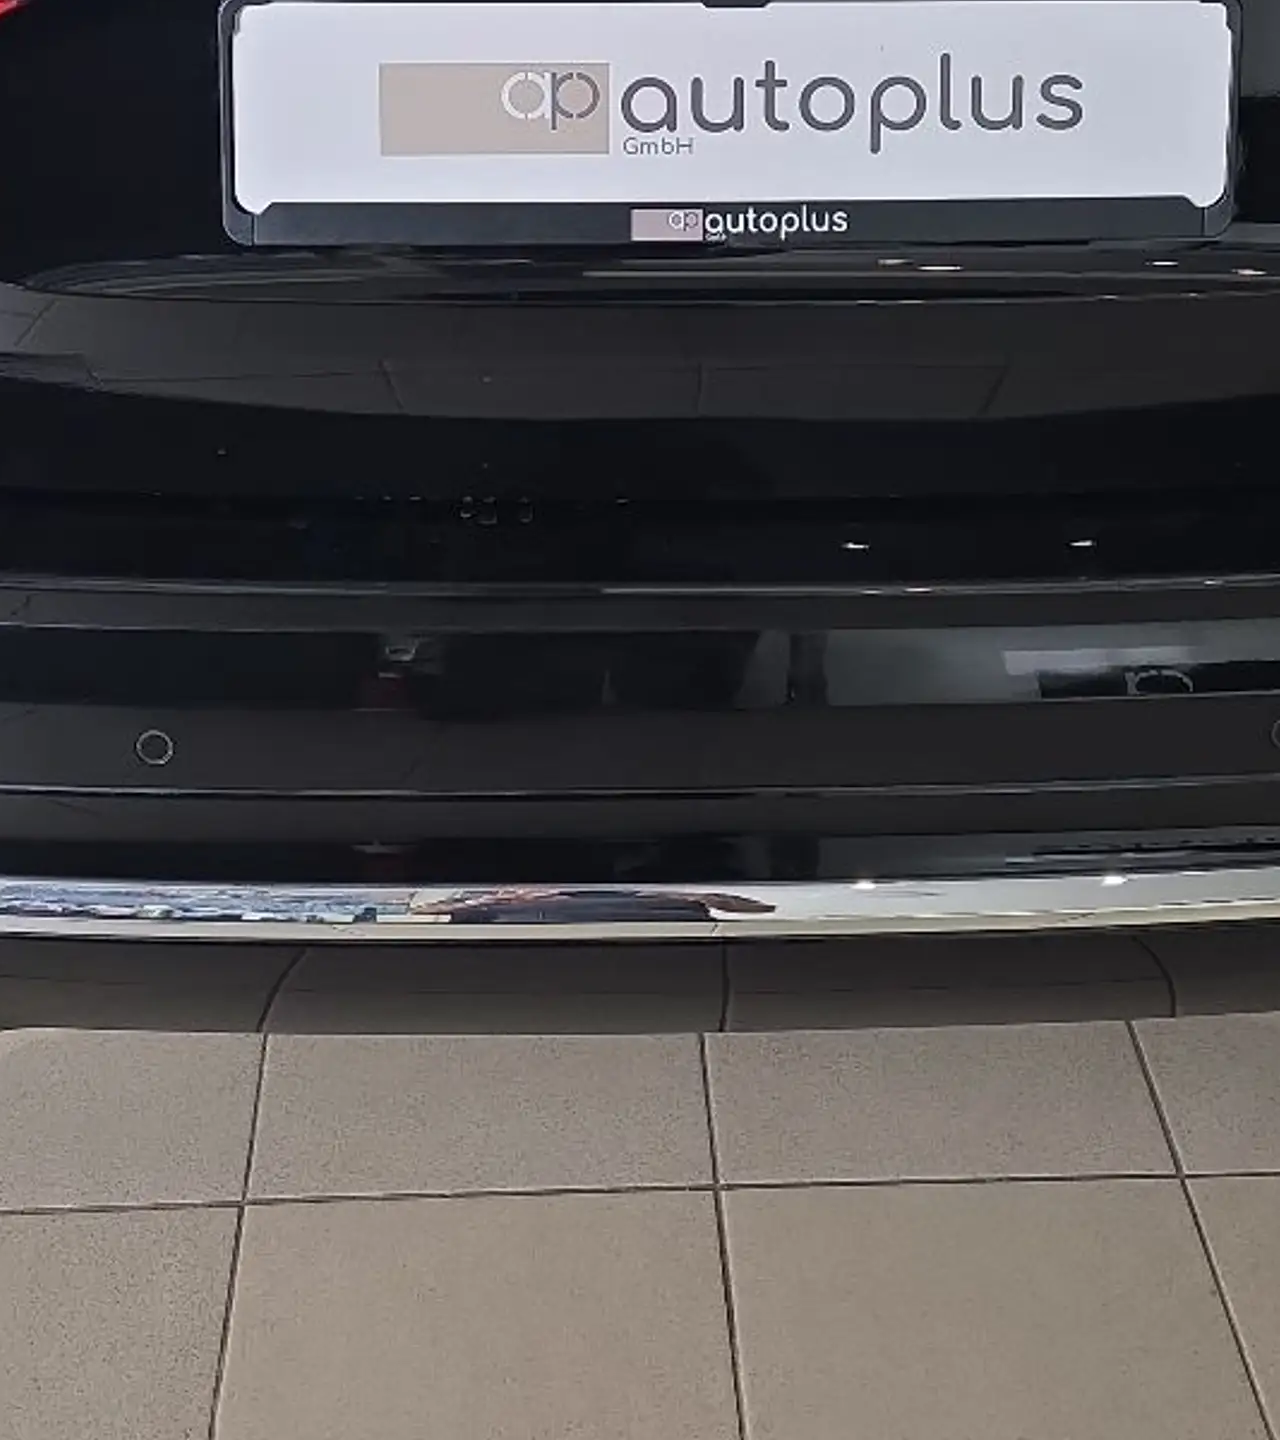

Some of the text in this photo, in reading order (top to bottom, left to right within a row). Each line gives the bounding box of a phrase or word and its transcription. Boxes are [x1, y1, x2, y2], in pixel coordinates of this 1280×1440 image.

[621, 53, 1084, 154] autoplus
[623, 137, 695, 156] GmbH
[704, 204, 850, 241] autoplus
